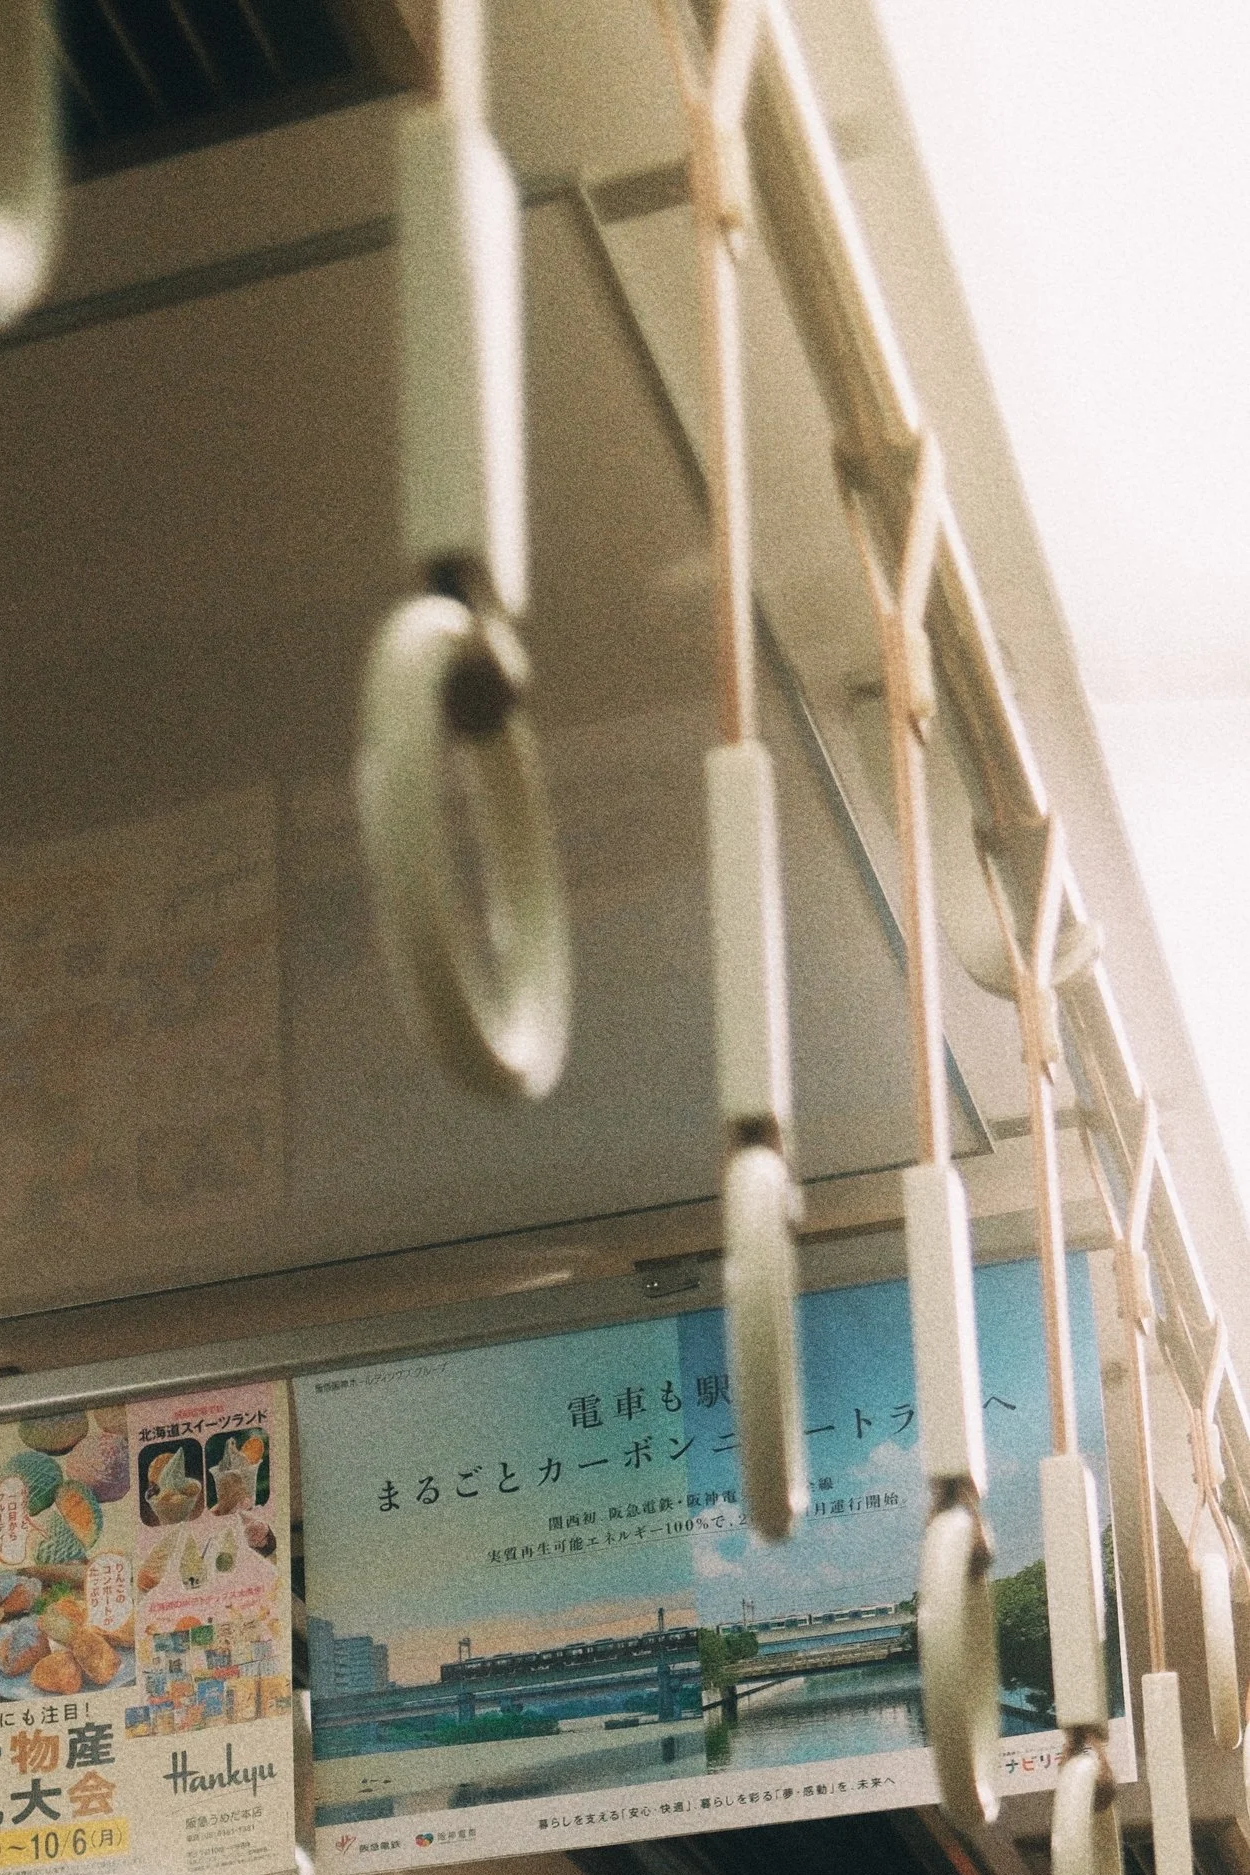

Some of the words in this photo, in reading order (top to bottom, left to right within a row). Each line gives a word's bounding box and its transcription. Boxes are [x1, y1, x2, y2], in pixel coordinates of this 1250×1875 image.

[138, 1409, 269, 1442] 北海道スイーツランド
[376, 1391, 1019, 1514] まるごとカーボンニートラへ
[162, 1741, 278, 1797] Hankyu
[185, 1805, 263, 1830] 阪急うめだ本店
[358, 1839, 402, 1854] 阪急電鉄
